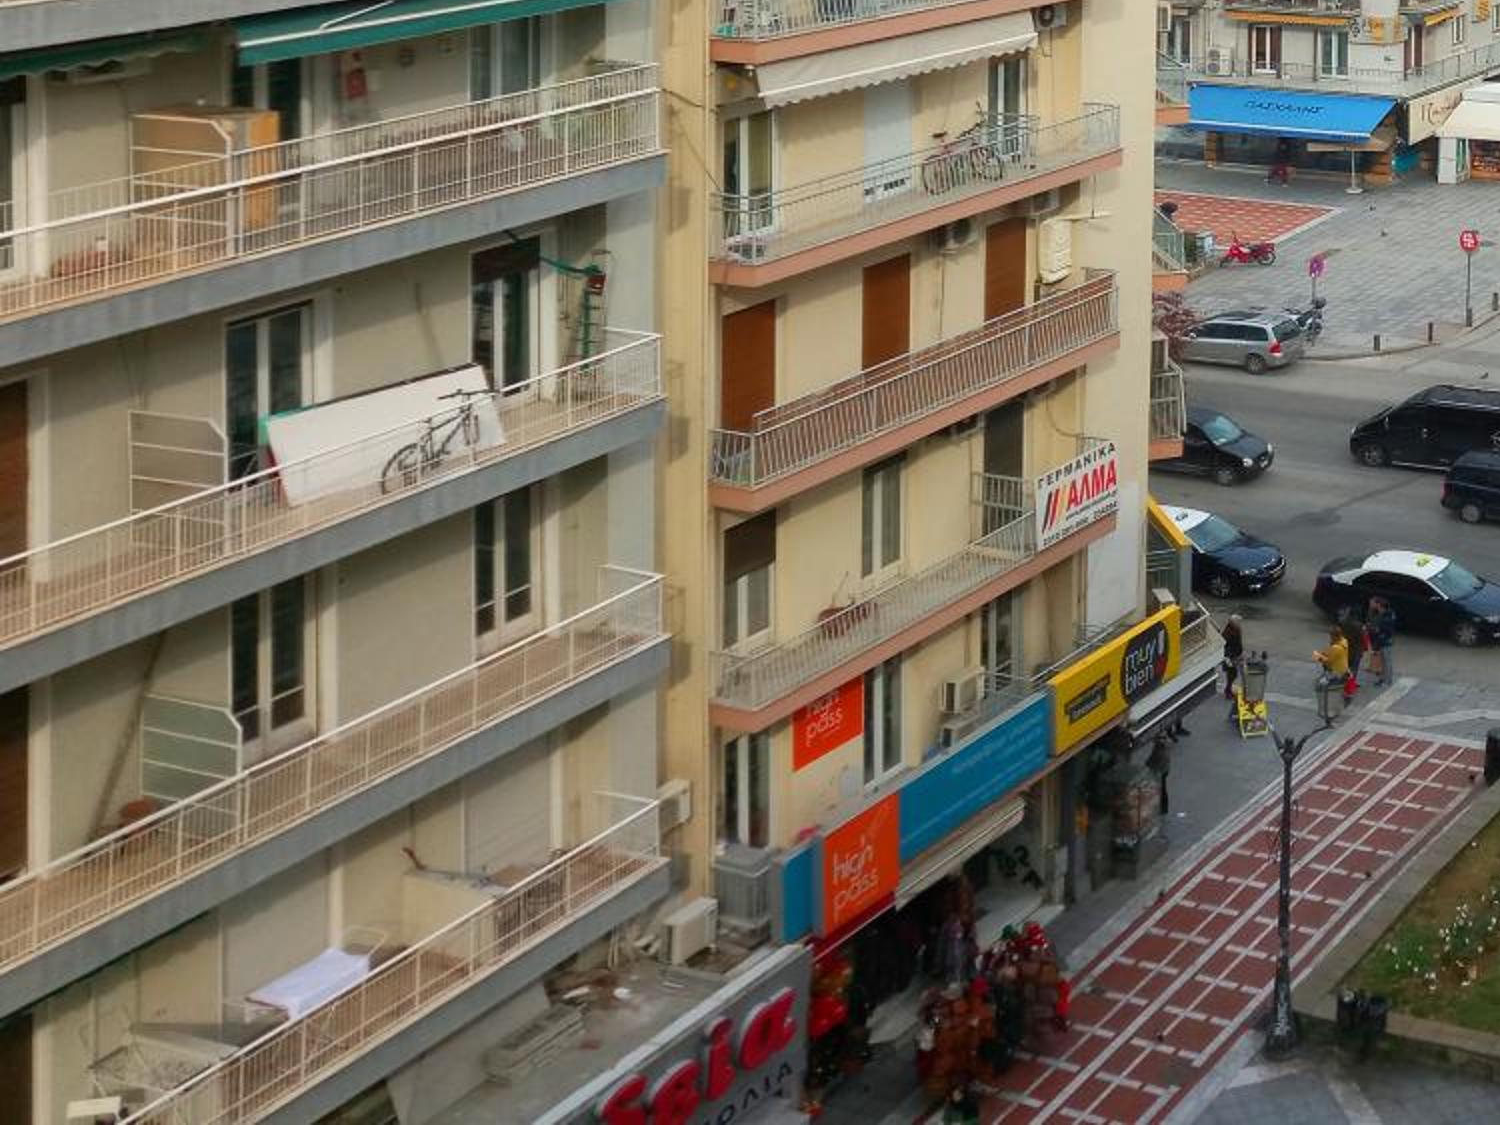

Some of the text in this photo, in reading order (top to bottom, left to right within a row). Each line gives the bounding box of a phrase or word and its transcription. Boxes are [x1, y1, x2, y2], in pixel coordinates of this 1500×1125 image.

[1124, 637, 1157, 675] muy
[1125, 661, 1153, 695] bien
[832, 833, 874, 886] high
[833, 866, 880, 924] pass
